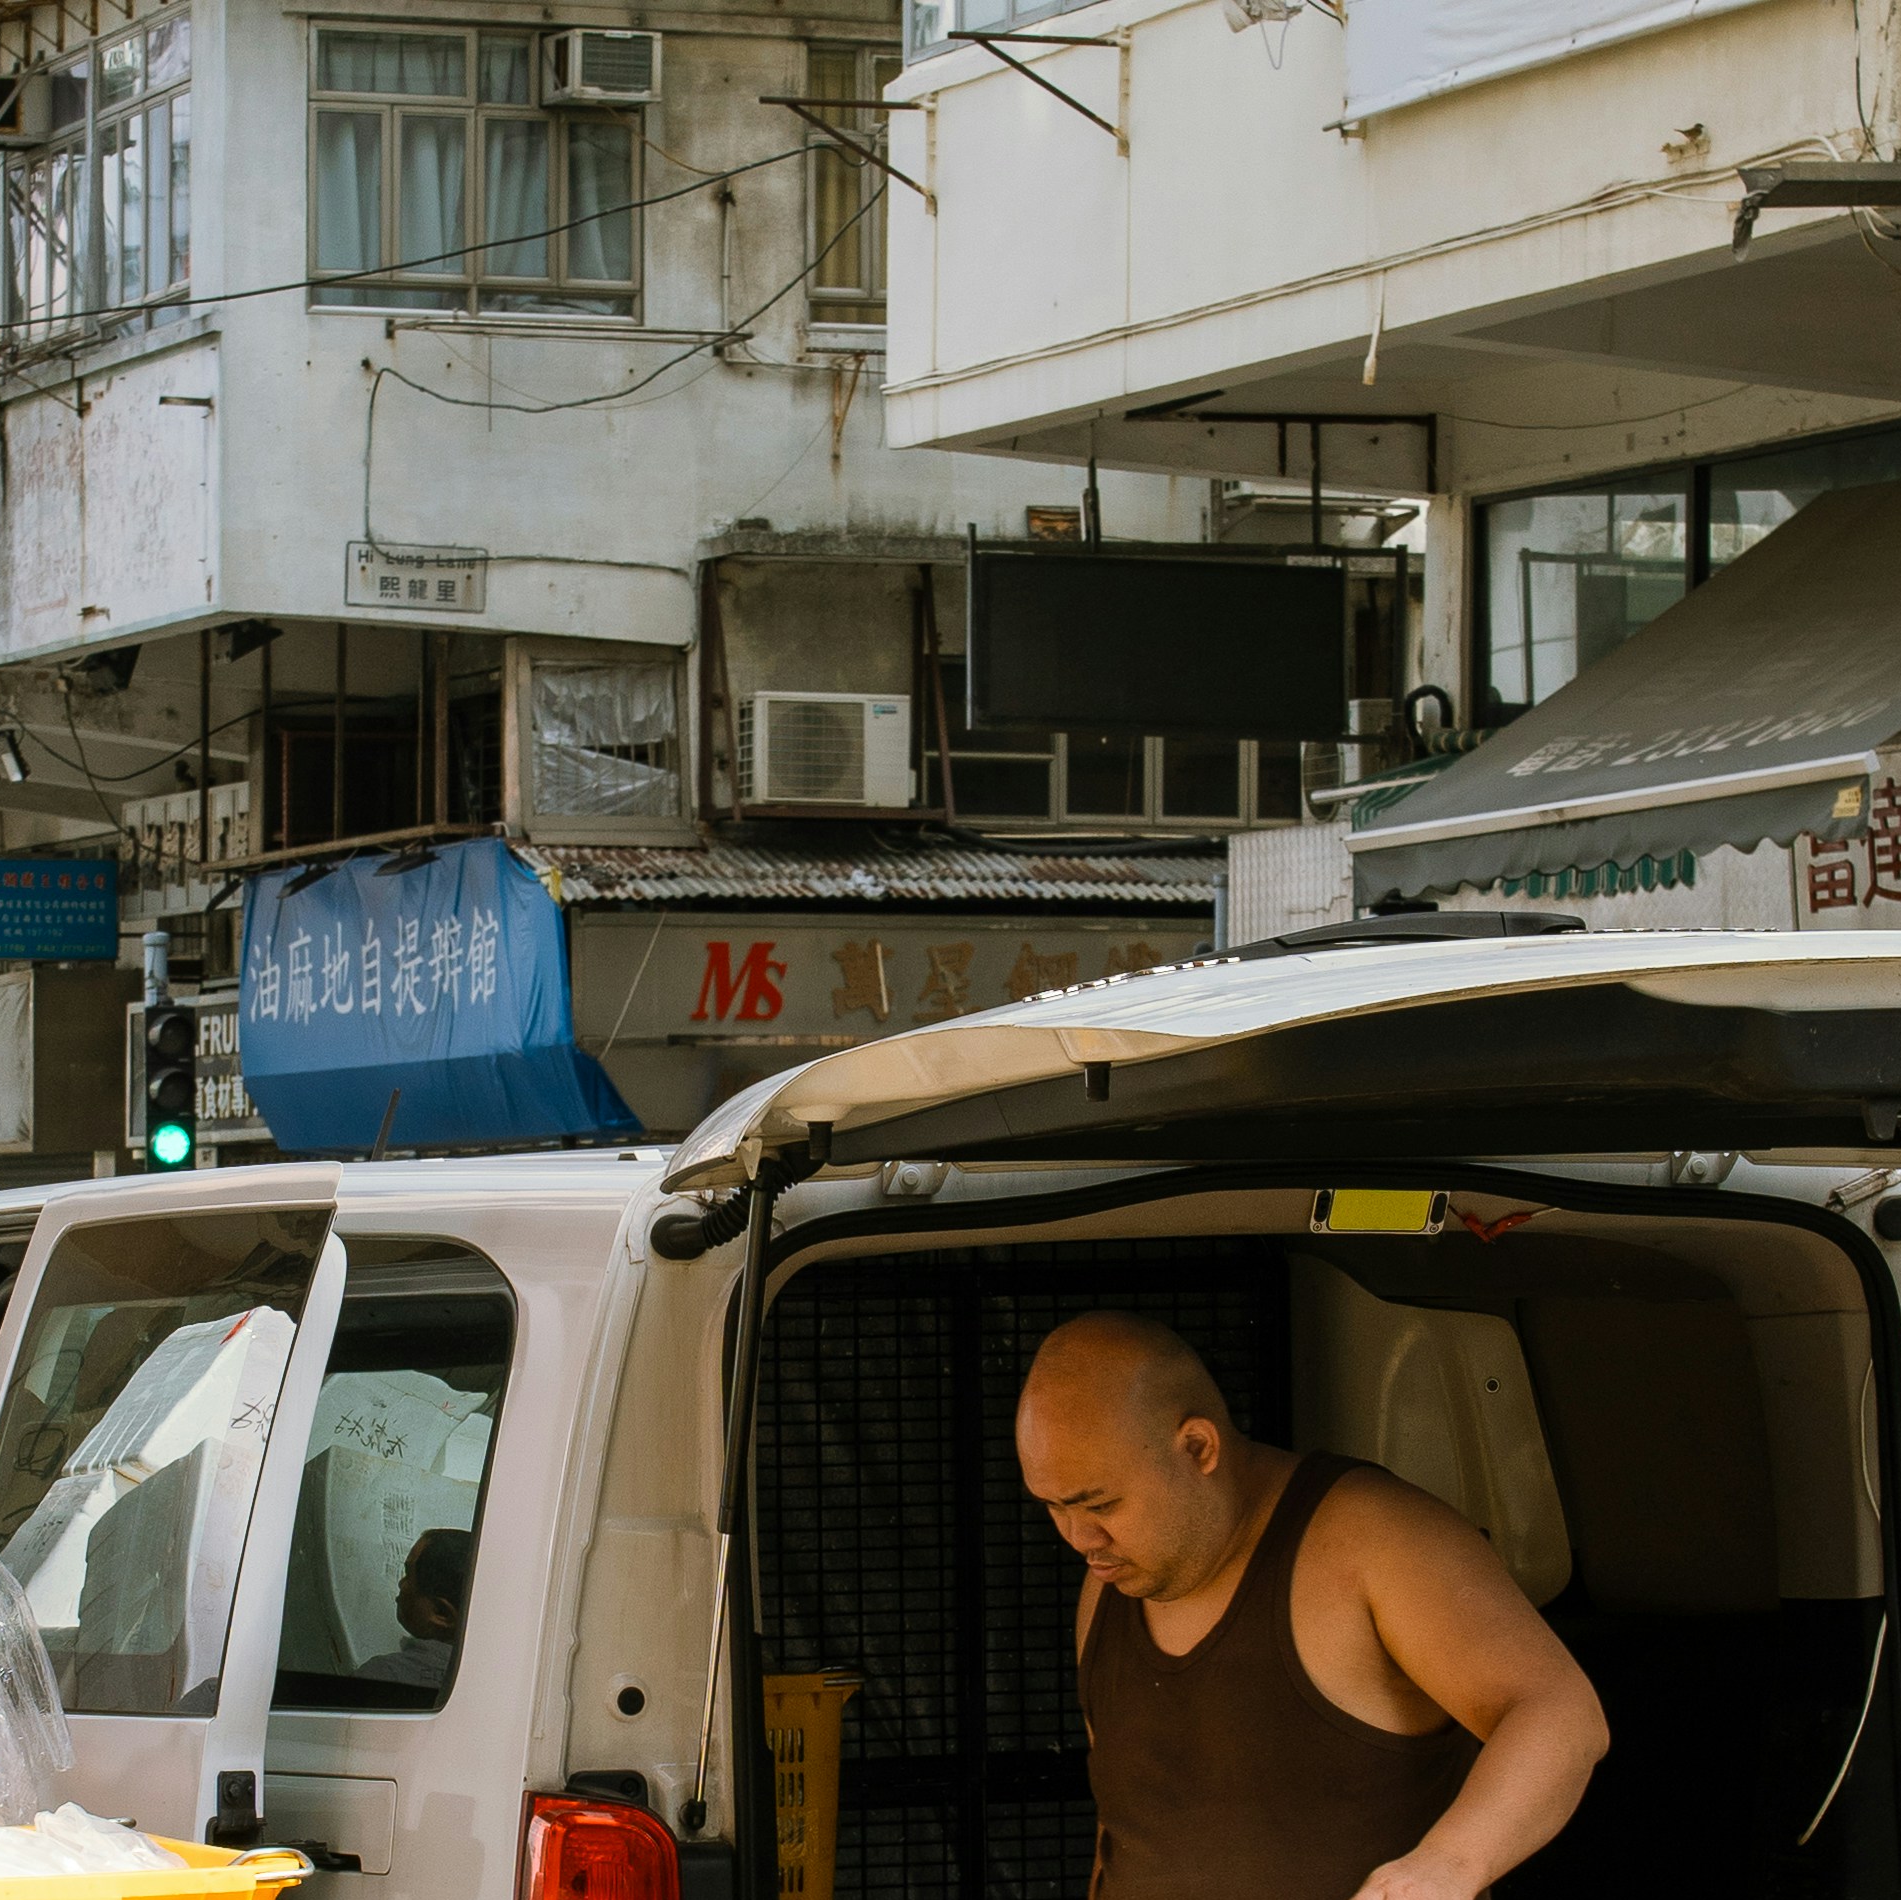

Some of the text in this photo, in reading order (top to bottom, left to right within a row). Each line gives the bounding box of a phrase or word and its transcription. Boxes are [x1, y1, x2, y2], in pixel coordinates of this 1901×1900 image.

[358, 550, 373, 563] Hi
[386, 552, 425, 569] Lung
[690, 941, 788, 1021] MS
